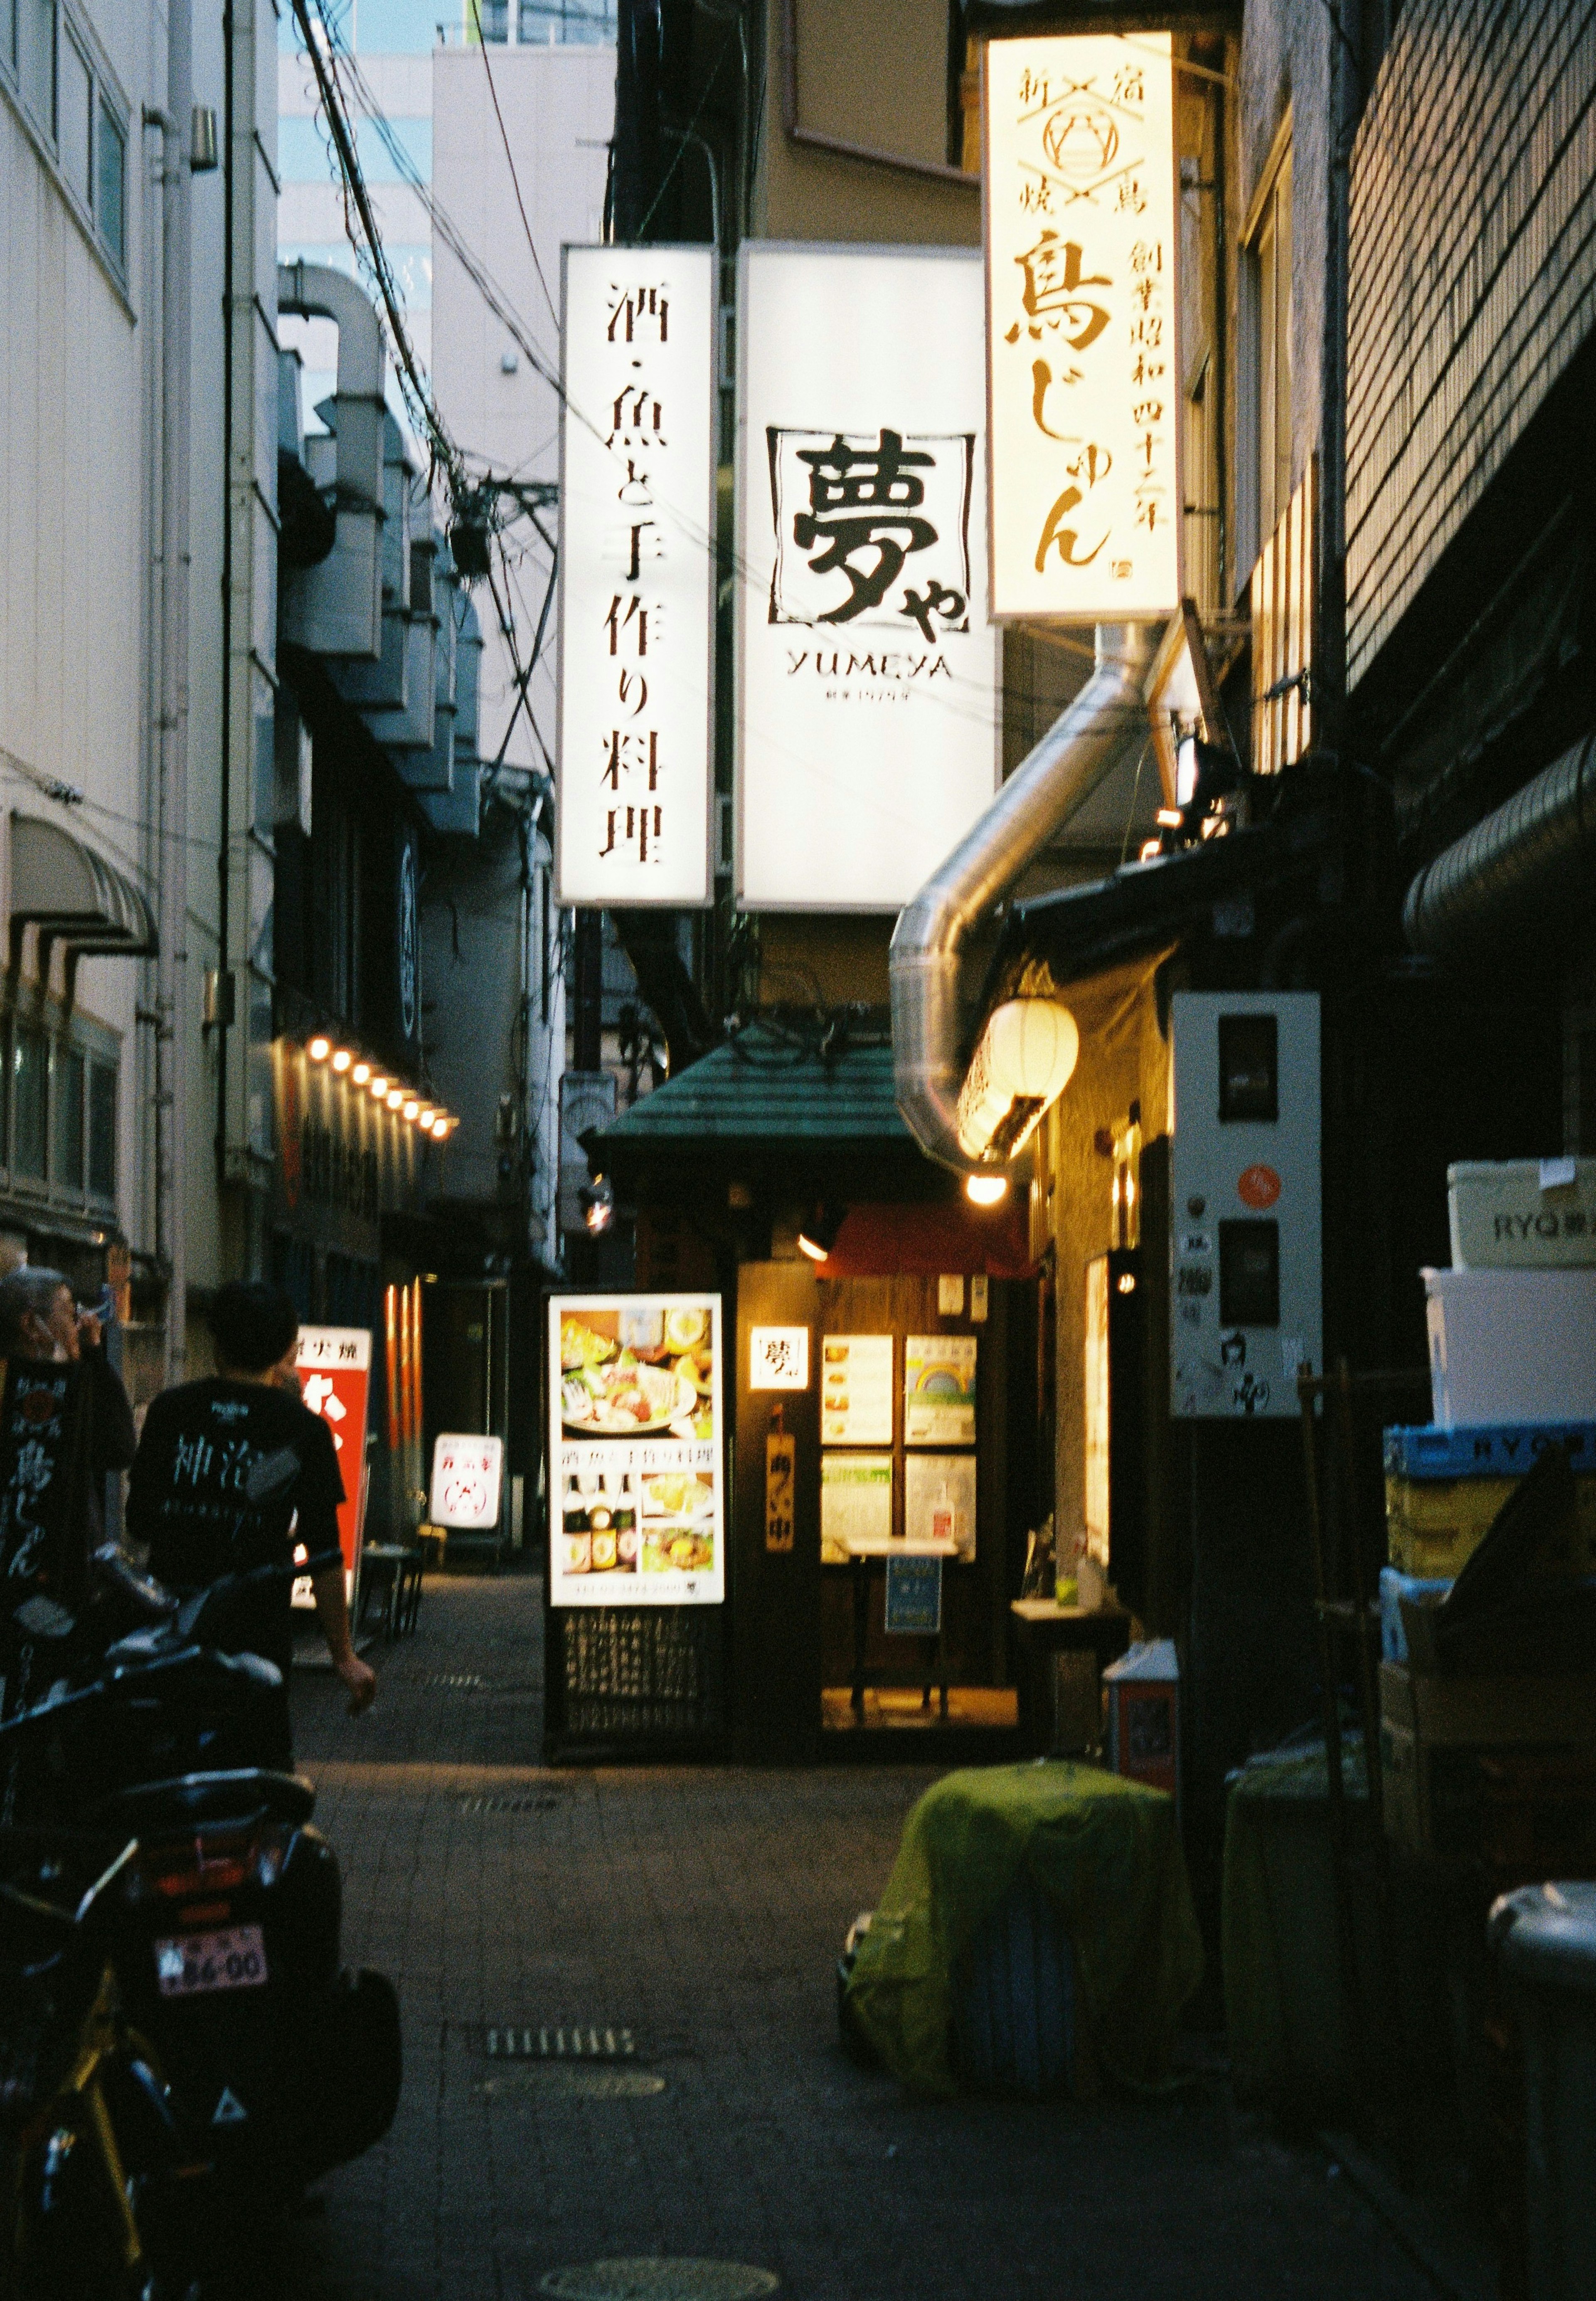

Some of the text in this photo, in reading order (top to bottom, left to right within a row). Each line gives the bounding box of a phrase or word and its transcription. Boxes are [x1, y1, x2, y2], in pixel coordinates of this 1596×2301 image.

[793, 428, 968, 644] 夢や
[1004, 230, 1114, 574] 鳥じゅん
[598, 279, 671, 866] 酒・魚と手作り料理
[786, 649, 953, 680] YUMEYA
